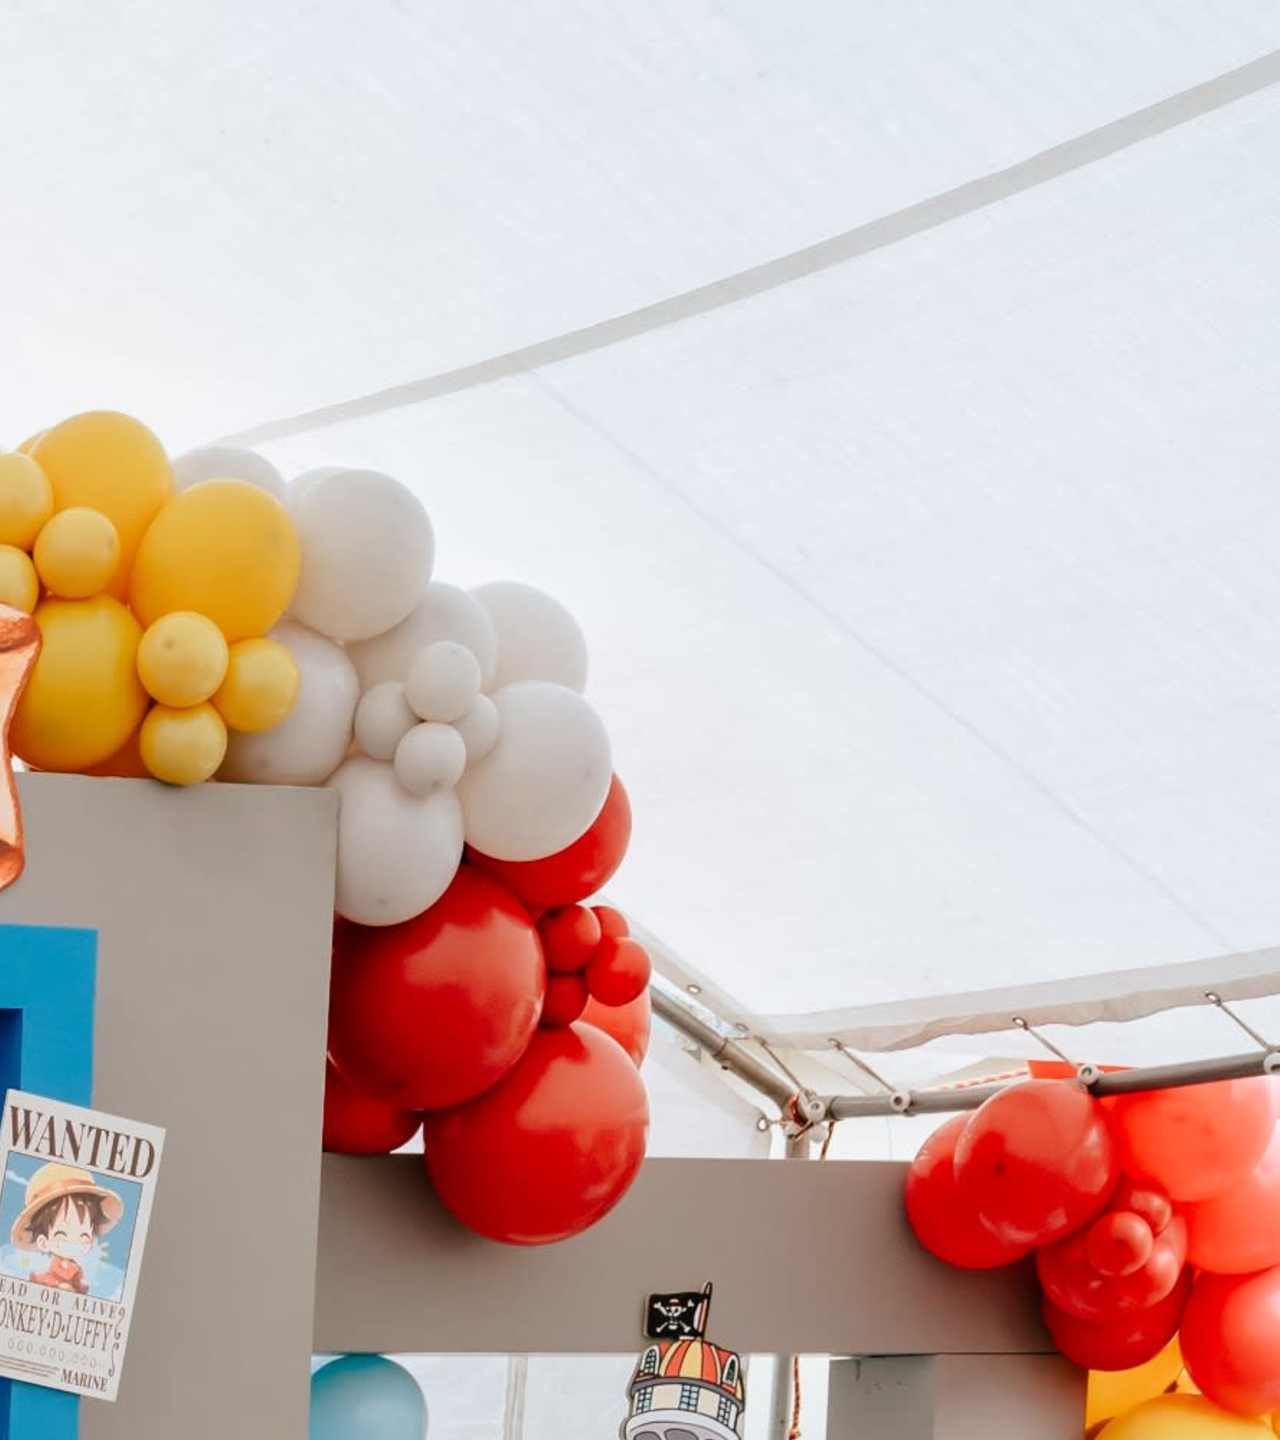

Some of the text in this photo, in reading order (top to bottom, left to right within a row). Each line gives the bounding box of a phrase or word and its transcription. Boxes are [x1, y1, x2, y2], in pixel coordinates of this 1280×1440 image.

[8, 1105, 156, 1180] WANTED
[41, 1286, 60, 1305] OR
[73, 1296, 118, 1319] ALIVE
[60, 1368, 109, 1393] MARINE
